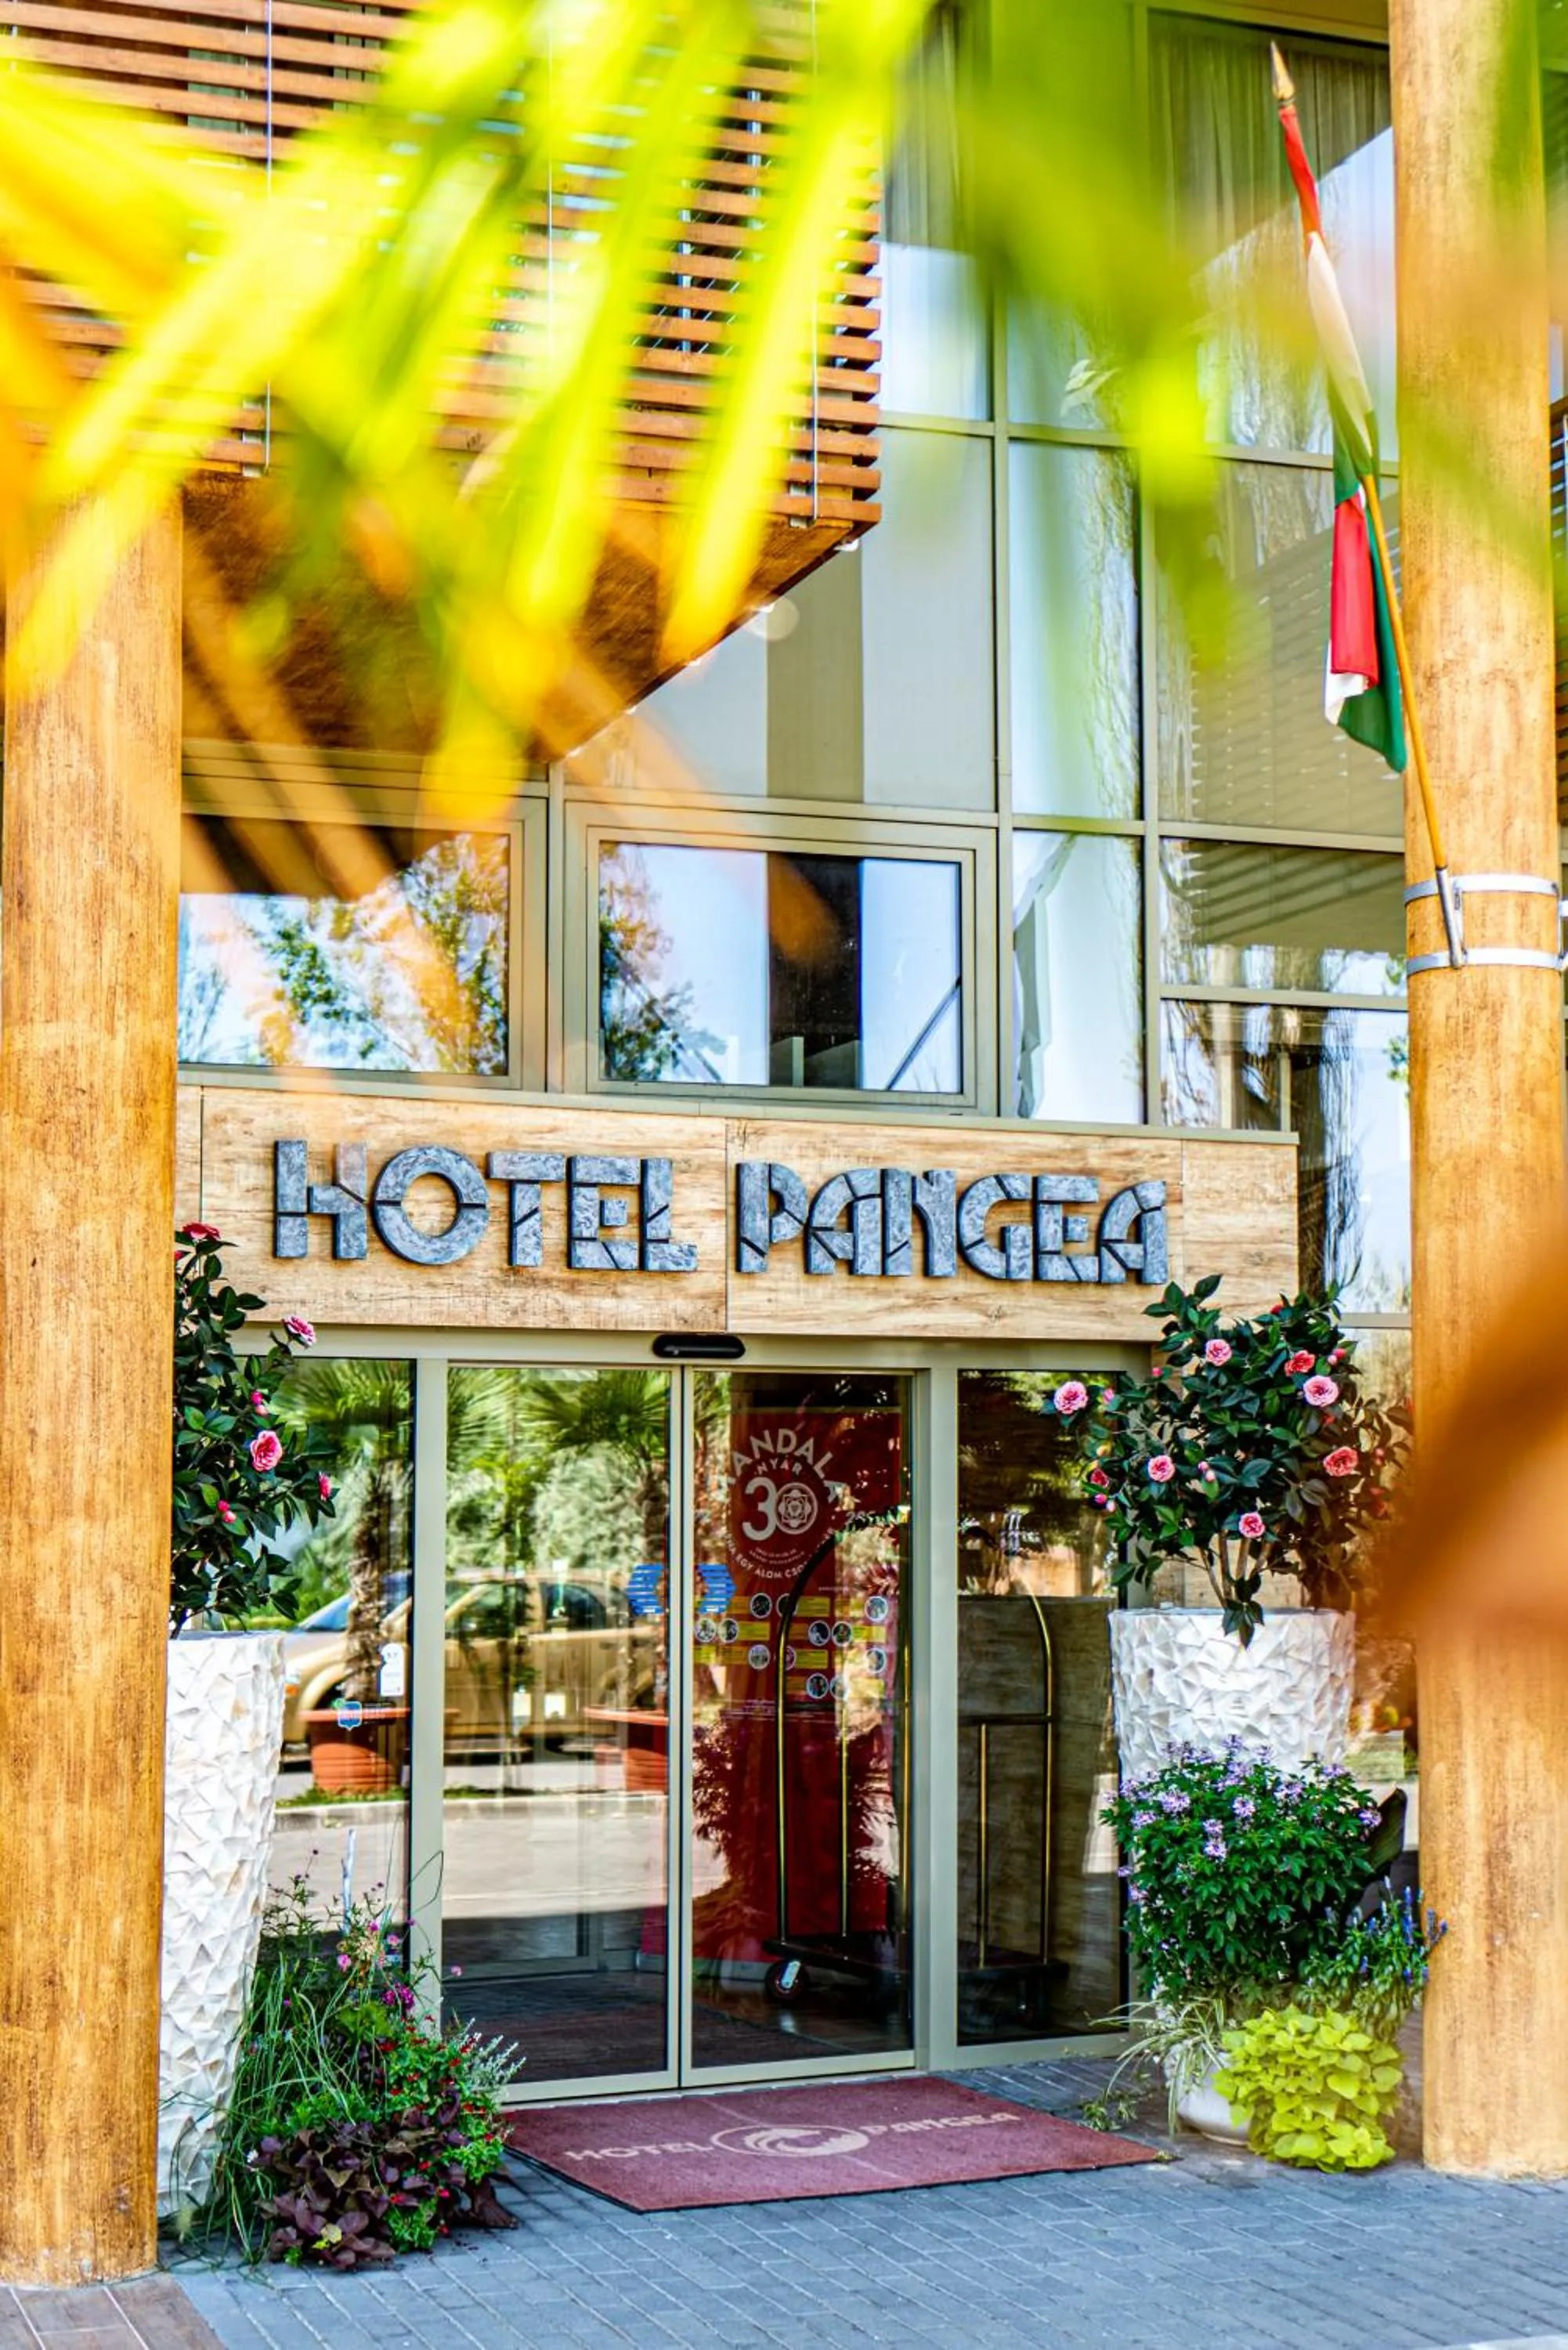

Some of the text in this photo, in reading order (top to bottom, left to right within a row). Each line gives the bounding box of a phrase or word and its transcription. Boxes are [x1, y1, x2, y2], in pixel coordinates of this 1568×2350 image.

[273, 1141, 1169, 1285] HOTEL PANGEA
[564, 2112, 1021, 2161] HOTEL PANGEA
